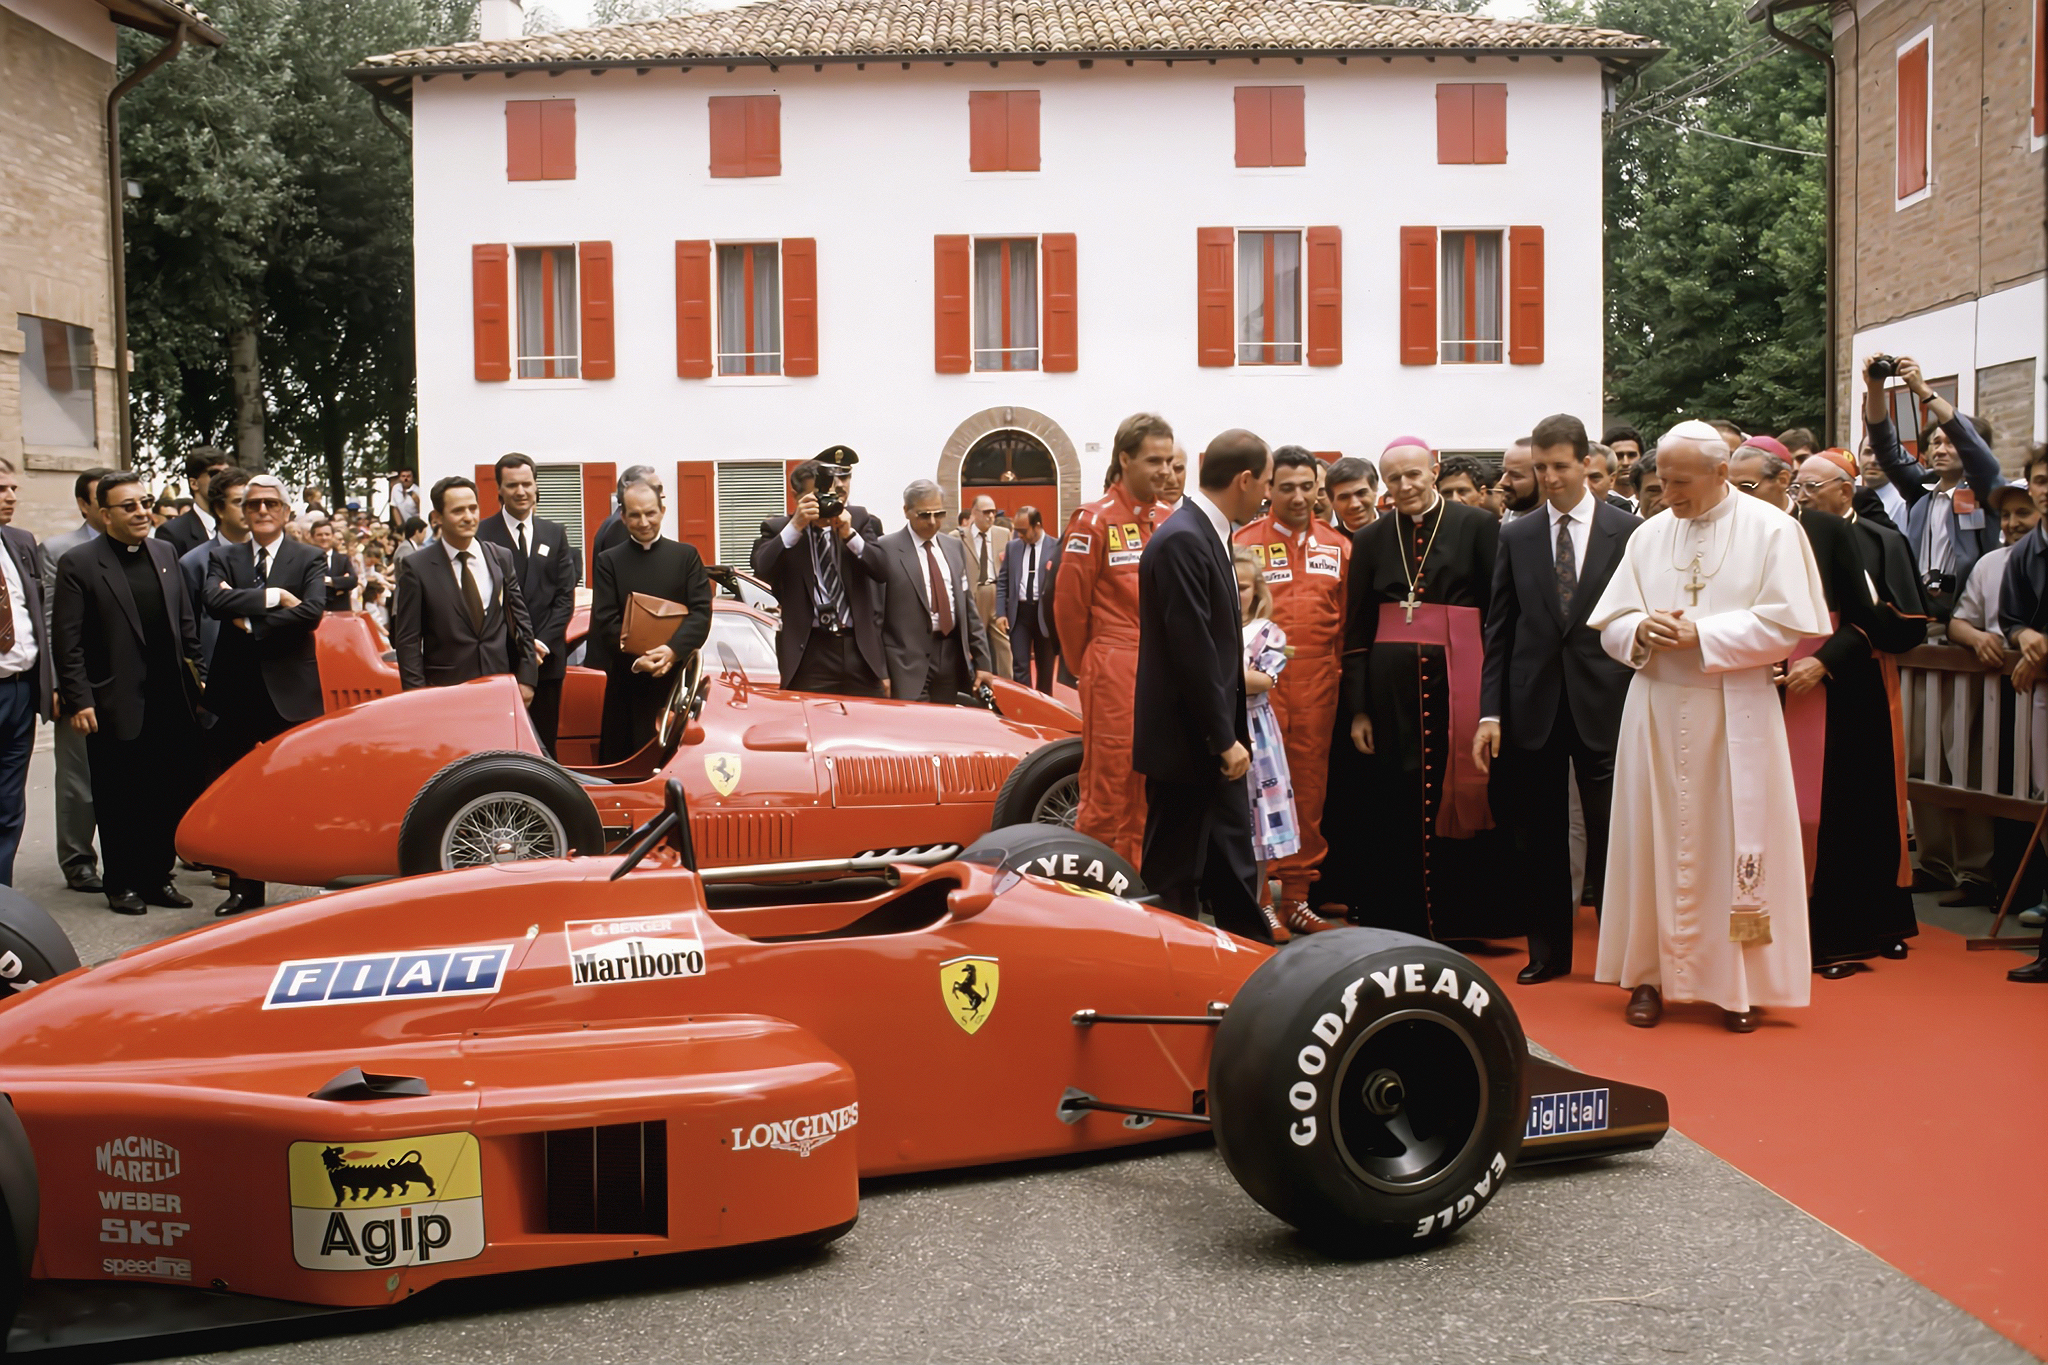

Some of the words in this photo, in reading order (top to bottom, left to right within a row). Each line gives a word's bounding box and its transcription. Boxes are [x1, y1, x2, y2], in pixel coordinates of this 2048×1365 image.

[1036, 854, 1129, 896] YEAR
[609, 920, 672, 934] BERGER
[287, 955, 495, 997] FIAT
[572, 941, 703, 983] Marlboro
[1289, 963, 1490, 1146] GOODYEAR
[732, 1102, 858, 1150] LONGINES
[1531, 1099, 1604, 1130] igital
[96, 1136, 180, 1175] MAGNETI
[96, 1142, 180, 1182] MARELLI
[99, 1191, 181, 1213] WEBER
[1413, 1152, 1507, 1237] EAGLE
[100, 1218, 190, 1246] SKF
[320, 1207, 452, 1266] Agip
